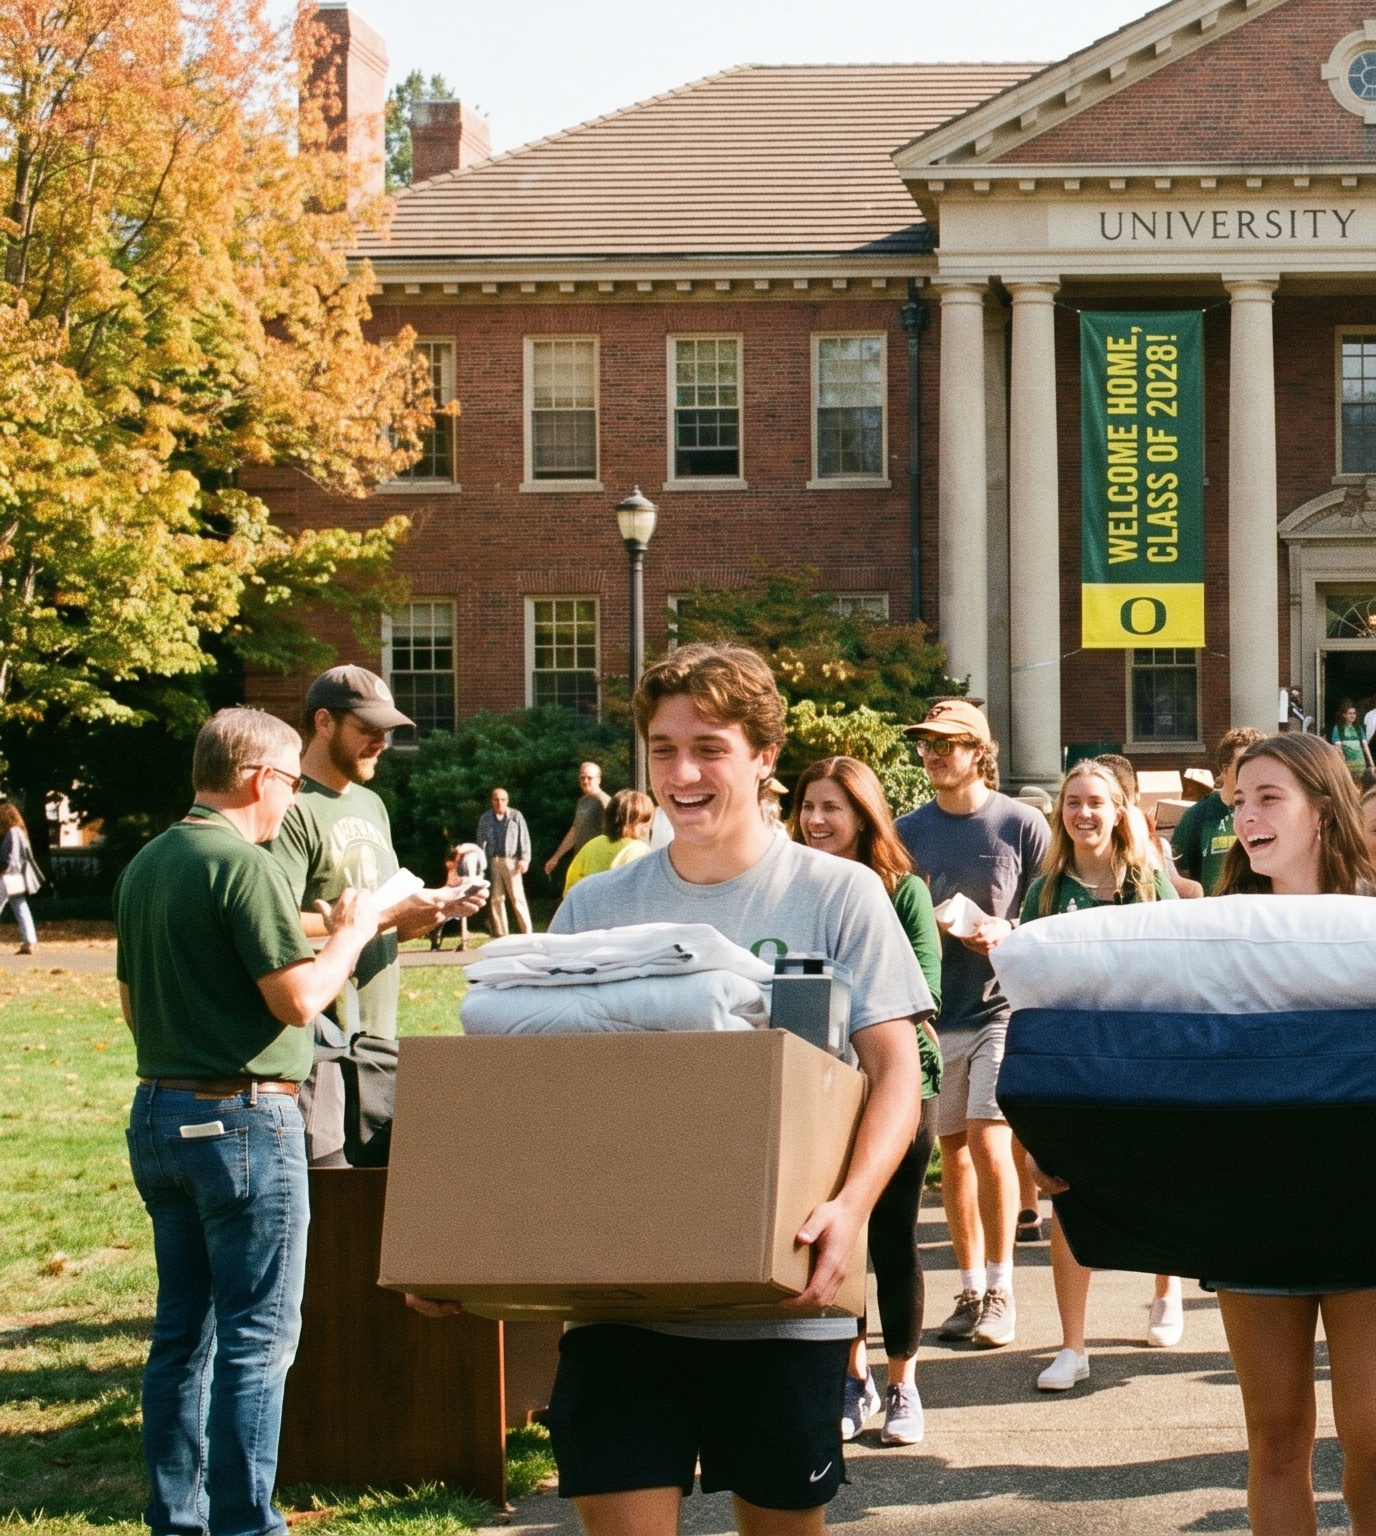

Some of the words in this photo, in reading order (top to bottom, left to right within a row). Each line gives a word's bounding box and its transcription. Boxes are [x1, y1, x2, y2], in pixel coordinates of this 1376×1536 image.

[1099, 208, 1356, 241] UNIVERSITY
[1106, 326, 1142, 415] HOME,
[1145, 334, 1178, 417] 2028!
[1146, 427, 1178, 463] OF
[1106, 424, 1139, 564] WELCOME
[1146, 472, 1179, 563] CLASS
[1119, 596, 1167, 636] O
